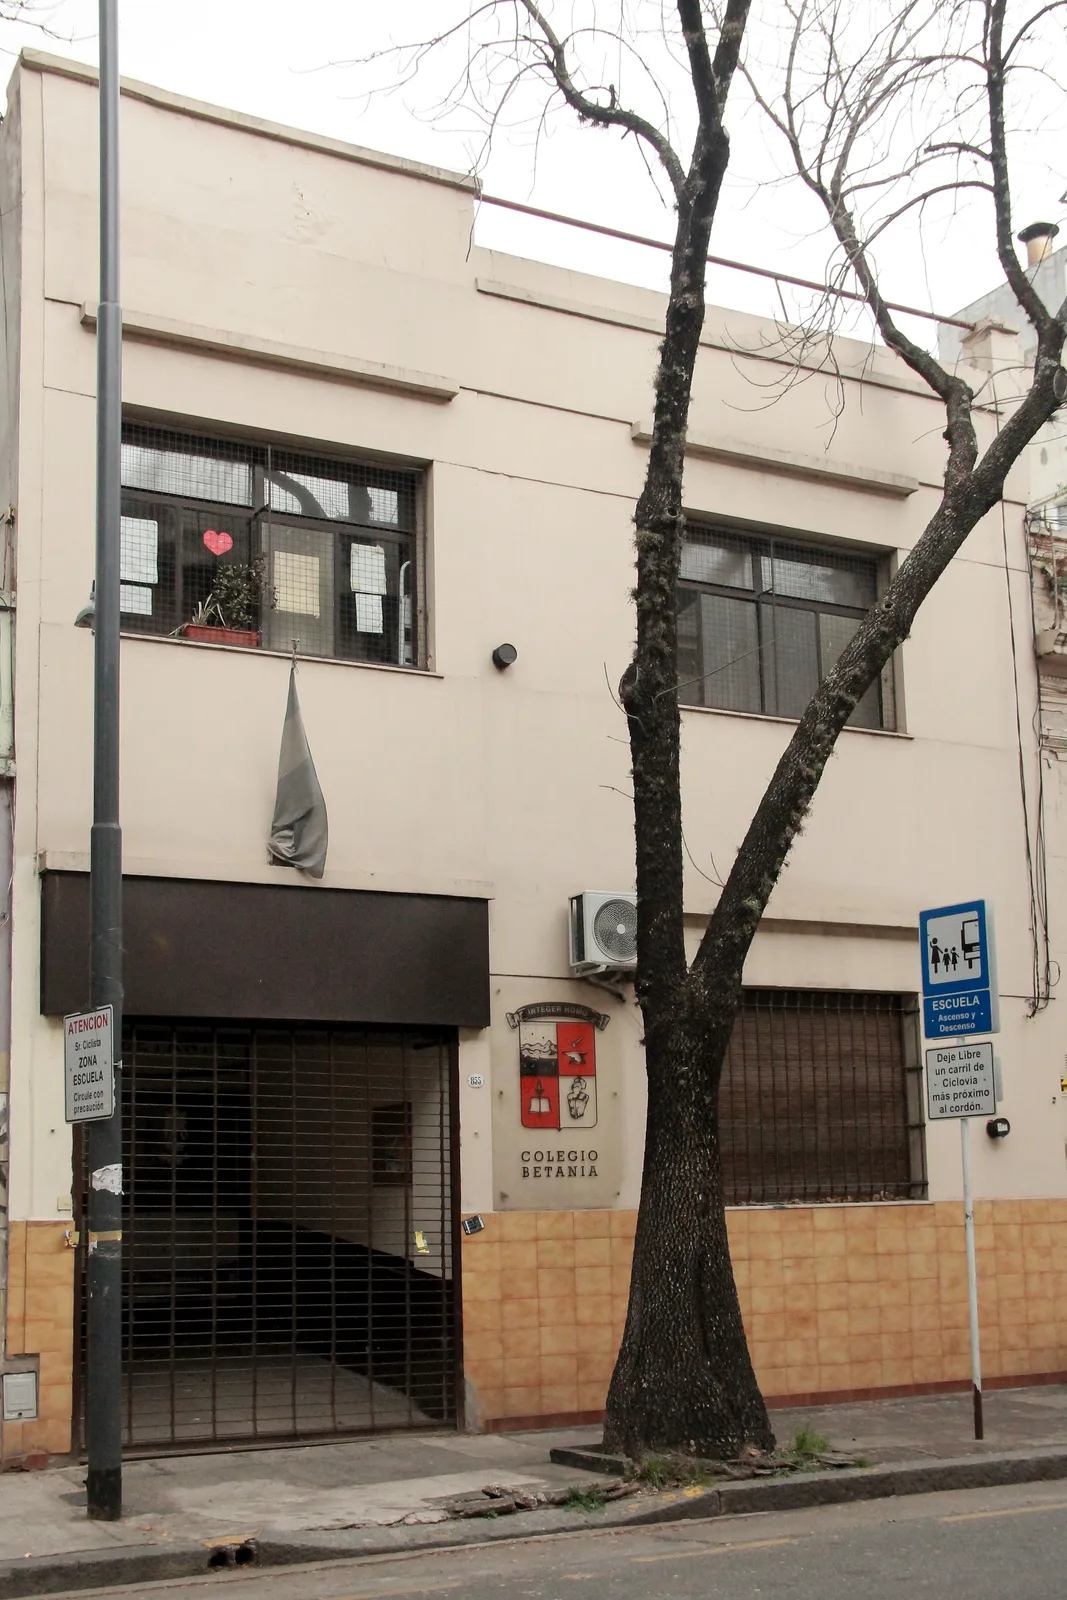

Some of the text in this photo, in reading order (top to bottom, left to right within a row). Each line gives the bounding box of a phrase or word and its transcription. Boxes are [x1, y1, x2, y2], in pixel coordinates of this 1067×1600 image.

[932, 995, 980, 1011] ESCUELA
[527, 1005, 588, 1016] INTEGER HOMO
[938, 1012, 976, 1022] Ascenso y
[68, 1013, 108, 1035] ATENCION
[939, 1022, 976, 1032] Descenso
[74, 1038, 101, 1051] Sr. Ciclista
[78, 1054, 97, 1068] ZONA
[936, 1049, 981, 1064] Deje Libre
[935, 1062, 984, 1075] un carril de
[73, 1070, 103, 1086] ESCUELA
[470, 1076, 482, 1085] 855
[942, 1076, 978, 1088] Ciclovia
[73, 1090, 104, 1102] Circule con
[932, 1088, 990, 1102] más próximo
[73, 1101, 104, 1115] precaución
[939, 1102, 983, 1113] al cordón.
[521, 1150, 598, 1162] COLEGIO
[522, 1165, 598, 1178] BETANIA
